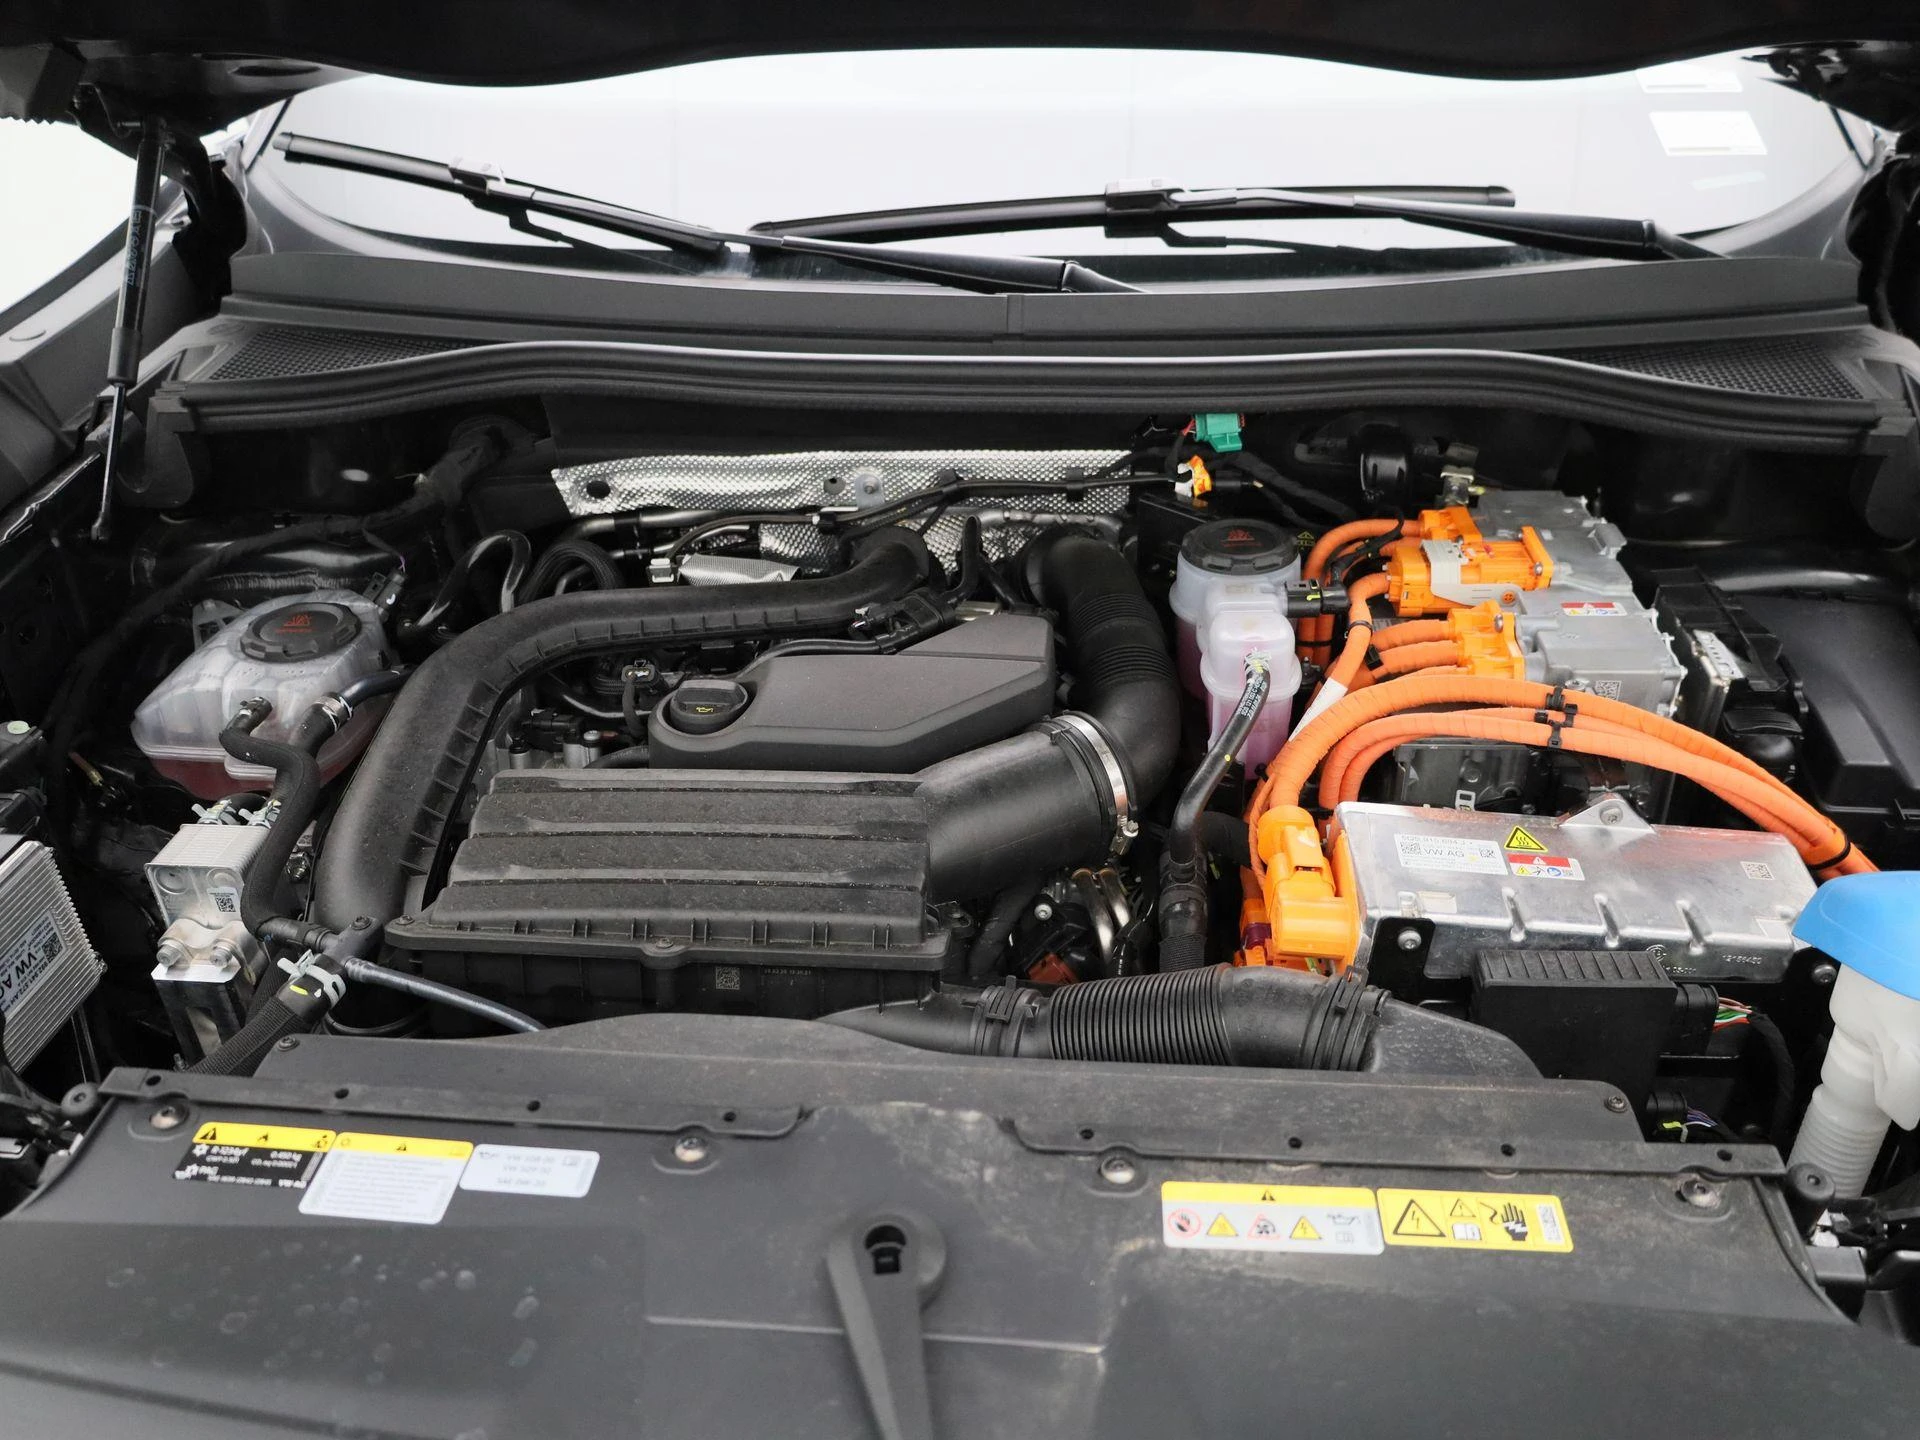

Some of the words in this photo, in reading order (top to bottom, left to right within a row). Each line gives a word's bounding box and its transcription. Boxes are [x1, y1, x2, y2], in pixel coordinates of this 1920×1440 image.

[1424, 848, 1443, 856] VW
[1447, 849, 1465, 858] AG
[12, 951, 38, 979] VW
